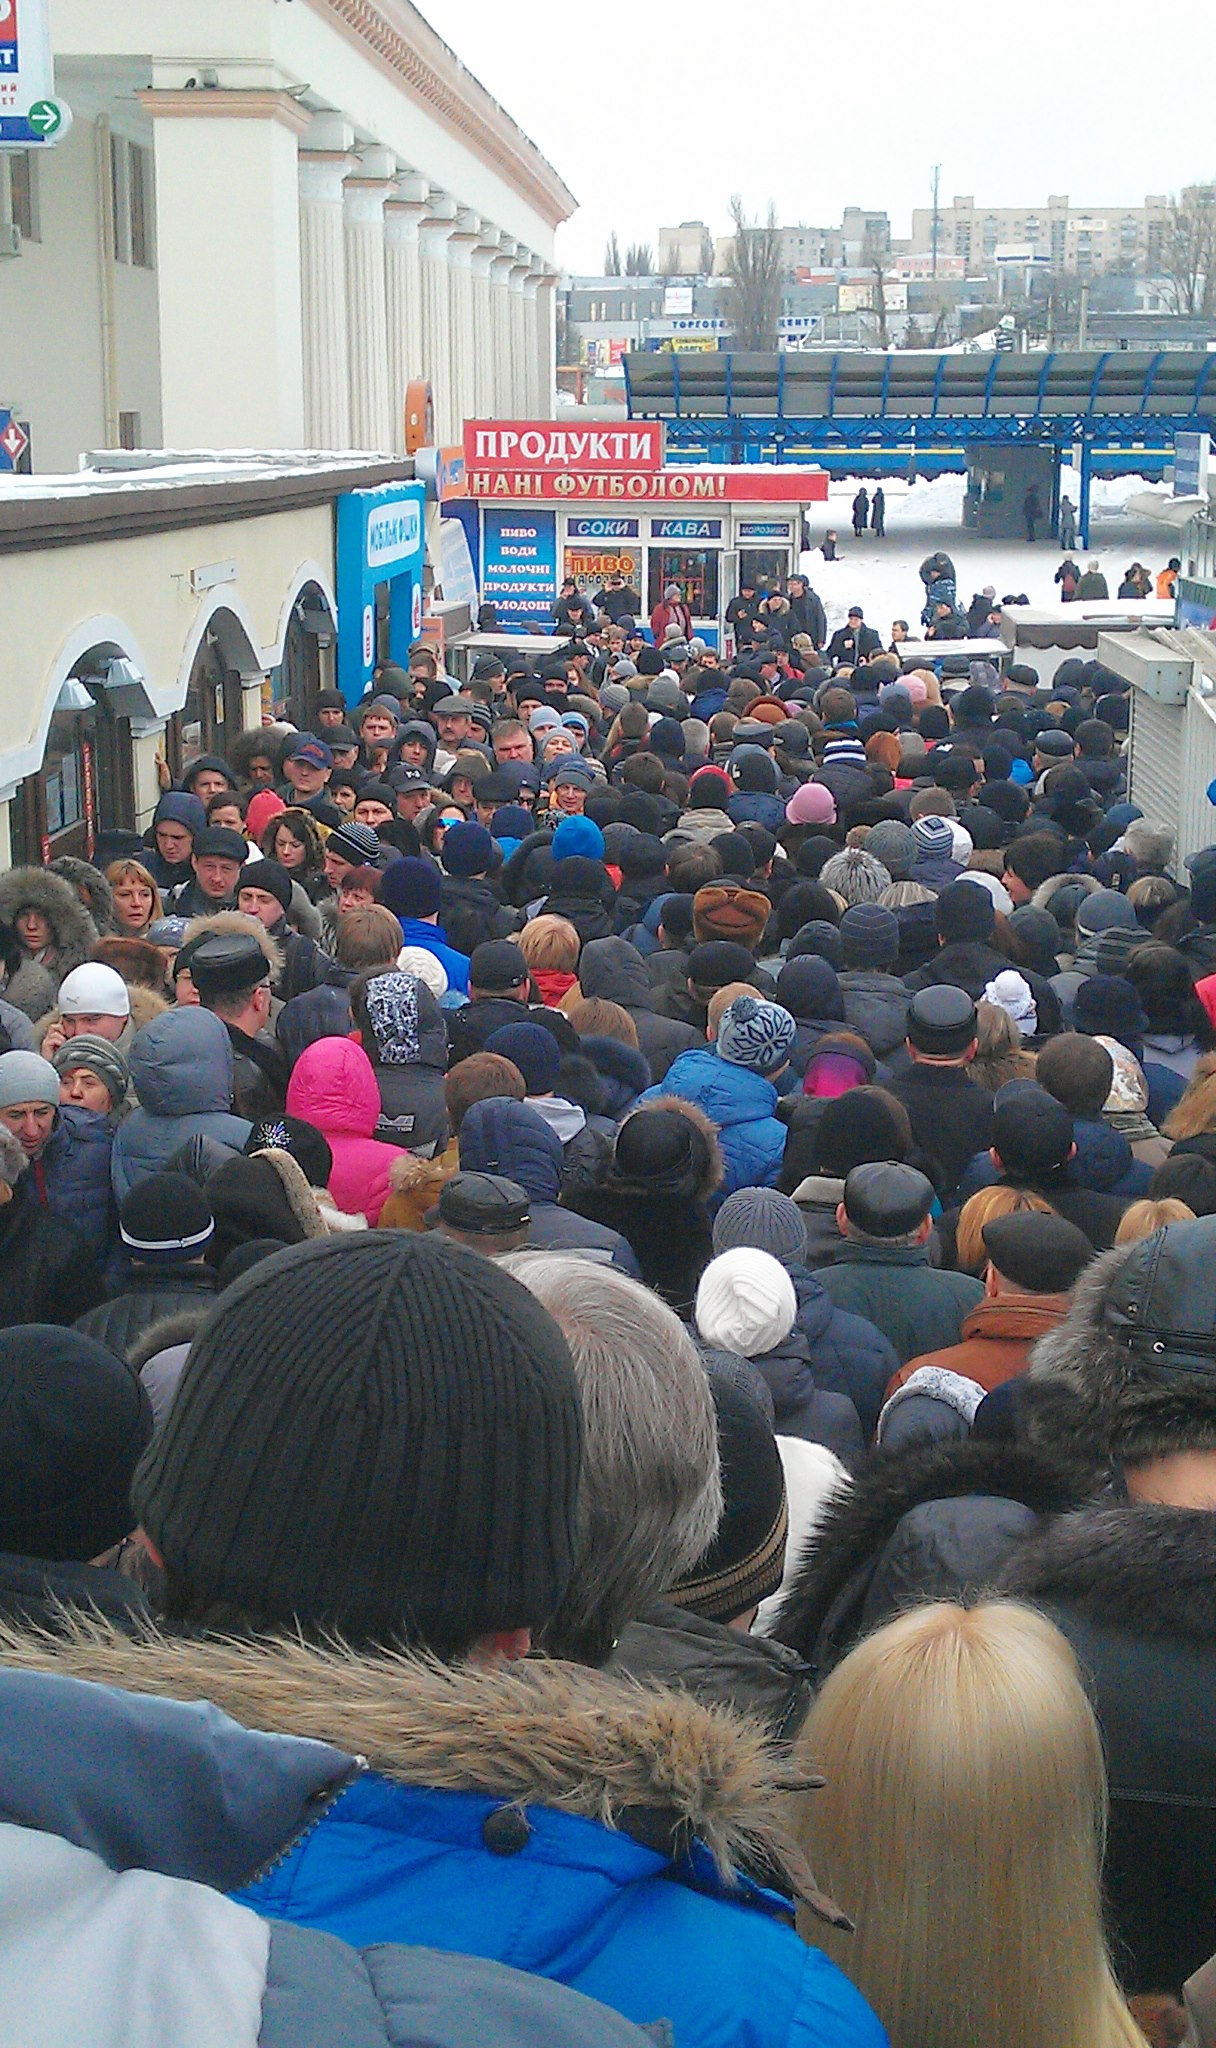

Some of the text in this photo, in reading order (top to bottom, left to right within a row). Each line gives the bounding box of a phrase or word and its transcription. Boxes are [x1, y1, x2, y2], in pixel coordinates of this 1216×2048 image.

[475, 431, 652, 465] ПРОДУКТИ
[466, 473, 543, 497] НАНІ
[553, 472, 726, 497] ФУТБОЛОМ!
[500, 528, 537, 538] ПИВО
[577, 521, 629, 535] СОКИ
[660, 521, 711, 536] КАВА
[500, 546, 537, 557] ВОДИ
[487, 564, 550, 574] МОЛОЧНІ
[571, 555, 635, 573] ПИВО
[484, 582, 554, 593] ПРОДУКТИ
